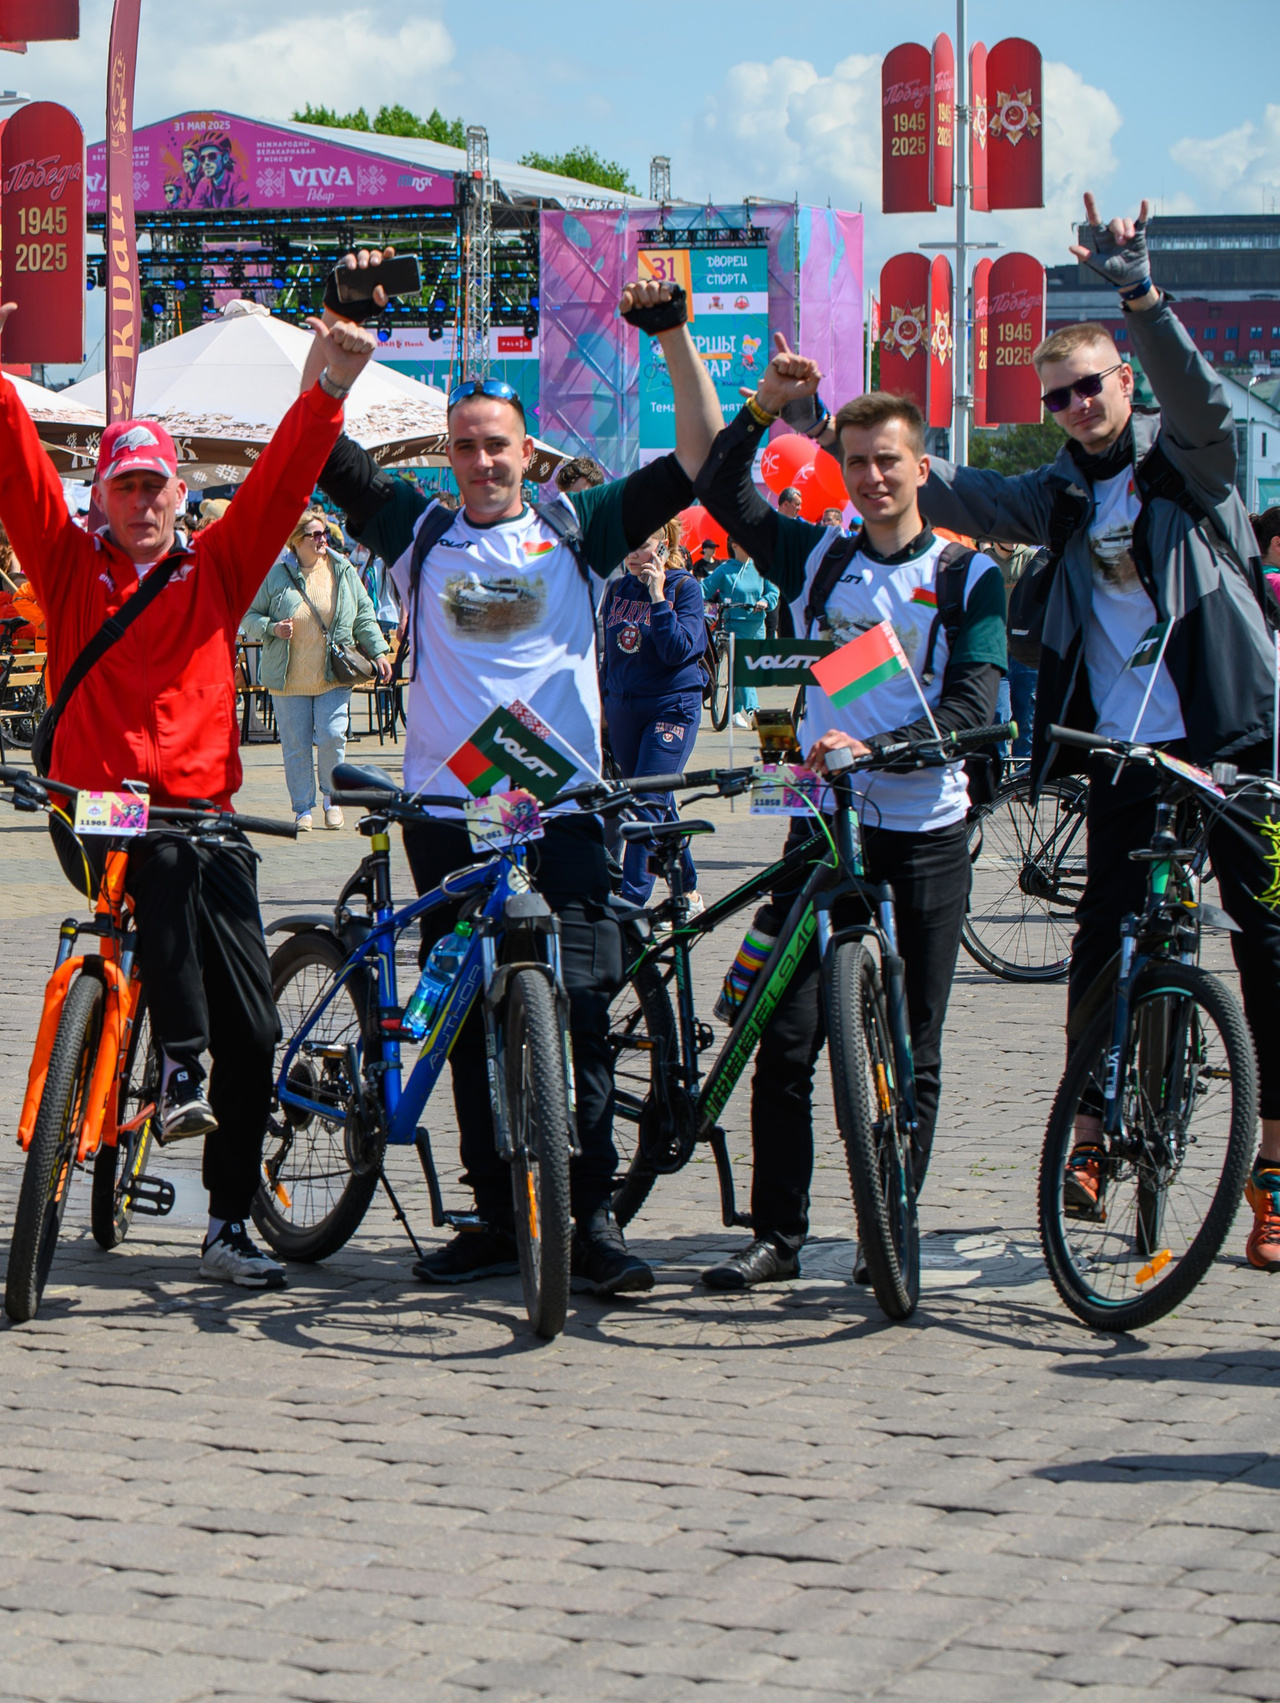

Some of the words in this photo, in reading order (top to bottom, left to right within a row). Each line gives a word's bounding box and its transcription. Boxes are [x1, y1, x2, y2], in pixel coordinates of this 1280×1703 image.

[174, 122, 185, 132] 31
[187, 121, 206, 131] МАЯ
[208, 120, 231, 130] 2025
[892, 113, 926, 133] 1945
[891, 137, 926, 157] 2025
[3, 155, 82, 201] Победа
[289, 165, 355, 188] VIVA
[17, 206, 68, 236] 1945
[15, 242, 68, 272] 2025
[706, 255, 748, 267] ДВОРЕЦ
[651, 257, 677, 282] 31
[706, 273, 748, 285] СПОРТА
[988, 289, 1043, 319] Победа
[998, 323, 1033, 343] 1945
[404, 339, 425, 348] Bank
[995, 347, 1034, 366] 2025
[744, 654, 821, 671] VOLAT
[492, 725, 559, 778] VOLAT
[429, 963, 483, 1071] AUTHOR
